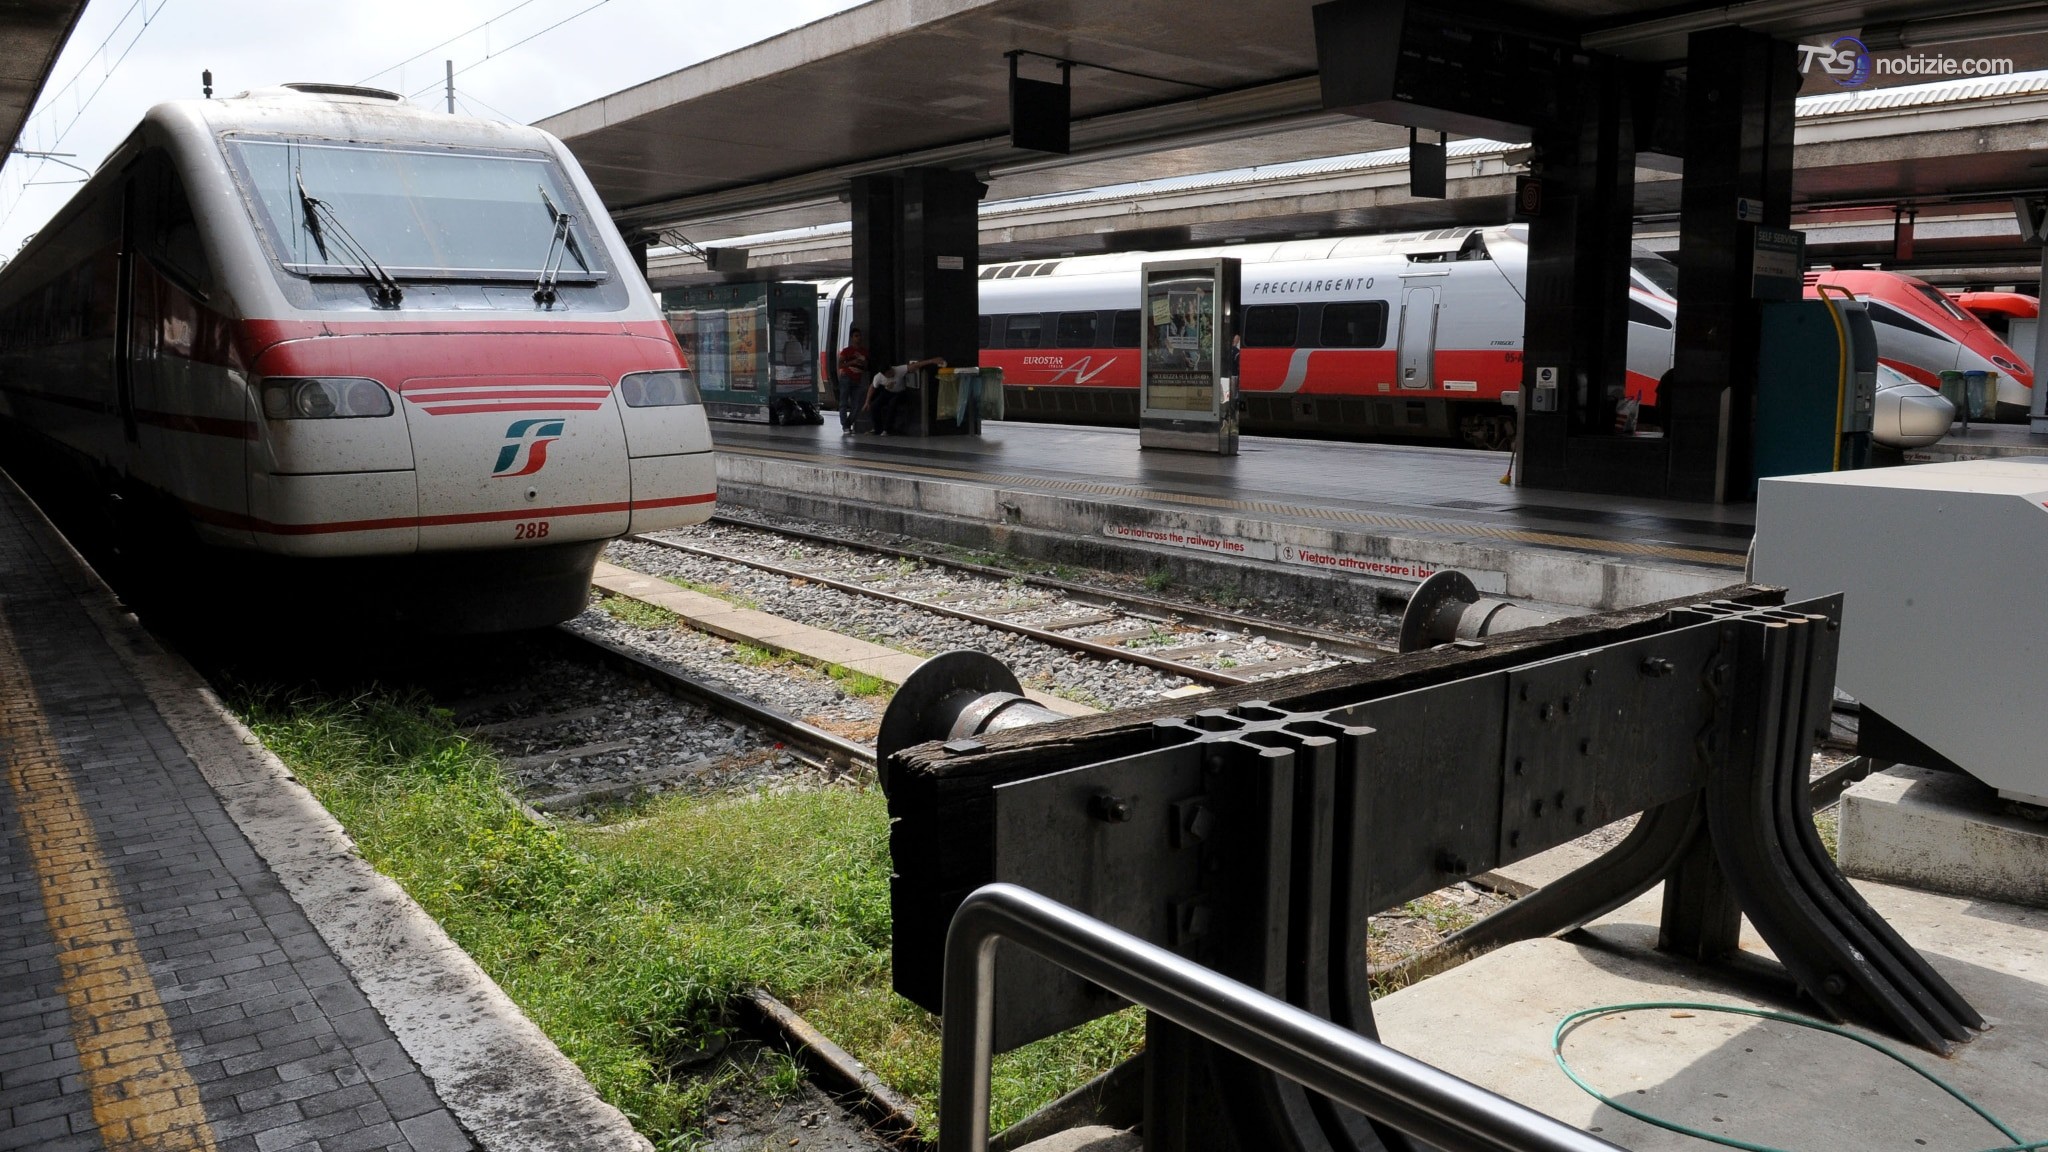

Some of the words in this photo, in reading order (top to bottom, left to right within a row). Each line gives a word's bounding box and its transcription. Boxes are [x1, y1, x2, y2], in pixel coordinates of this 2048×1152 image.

[1758, 231, 1773, 242] SELF
[1774, 233, 1798, 246] SERVICE
[1252, 276, 1375, 295] FRECCIARGENTO
[1023, 356, 1063, 366] EUROSTAR
[515, 522, 549, 540] 28B
[1118, 526, 1129, 535] Do
[1131, 529, 1145, 538] not
[1146, 531, 1167, 541] cross
[1169, 532, 1183, 543] the
[1186, 535, 1221, 551] railway
[1222, 539, 1245, 552] lines
[1298, 549, 1337, 565] Vietato
[1338, 557, 1410, 576] attraversare
